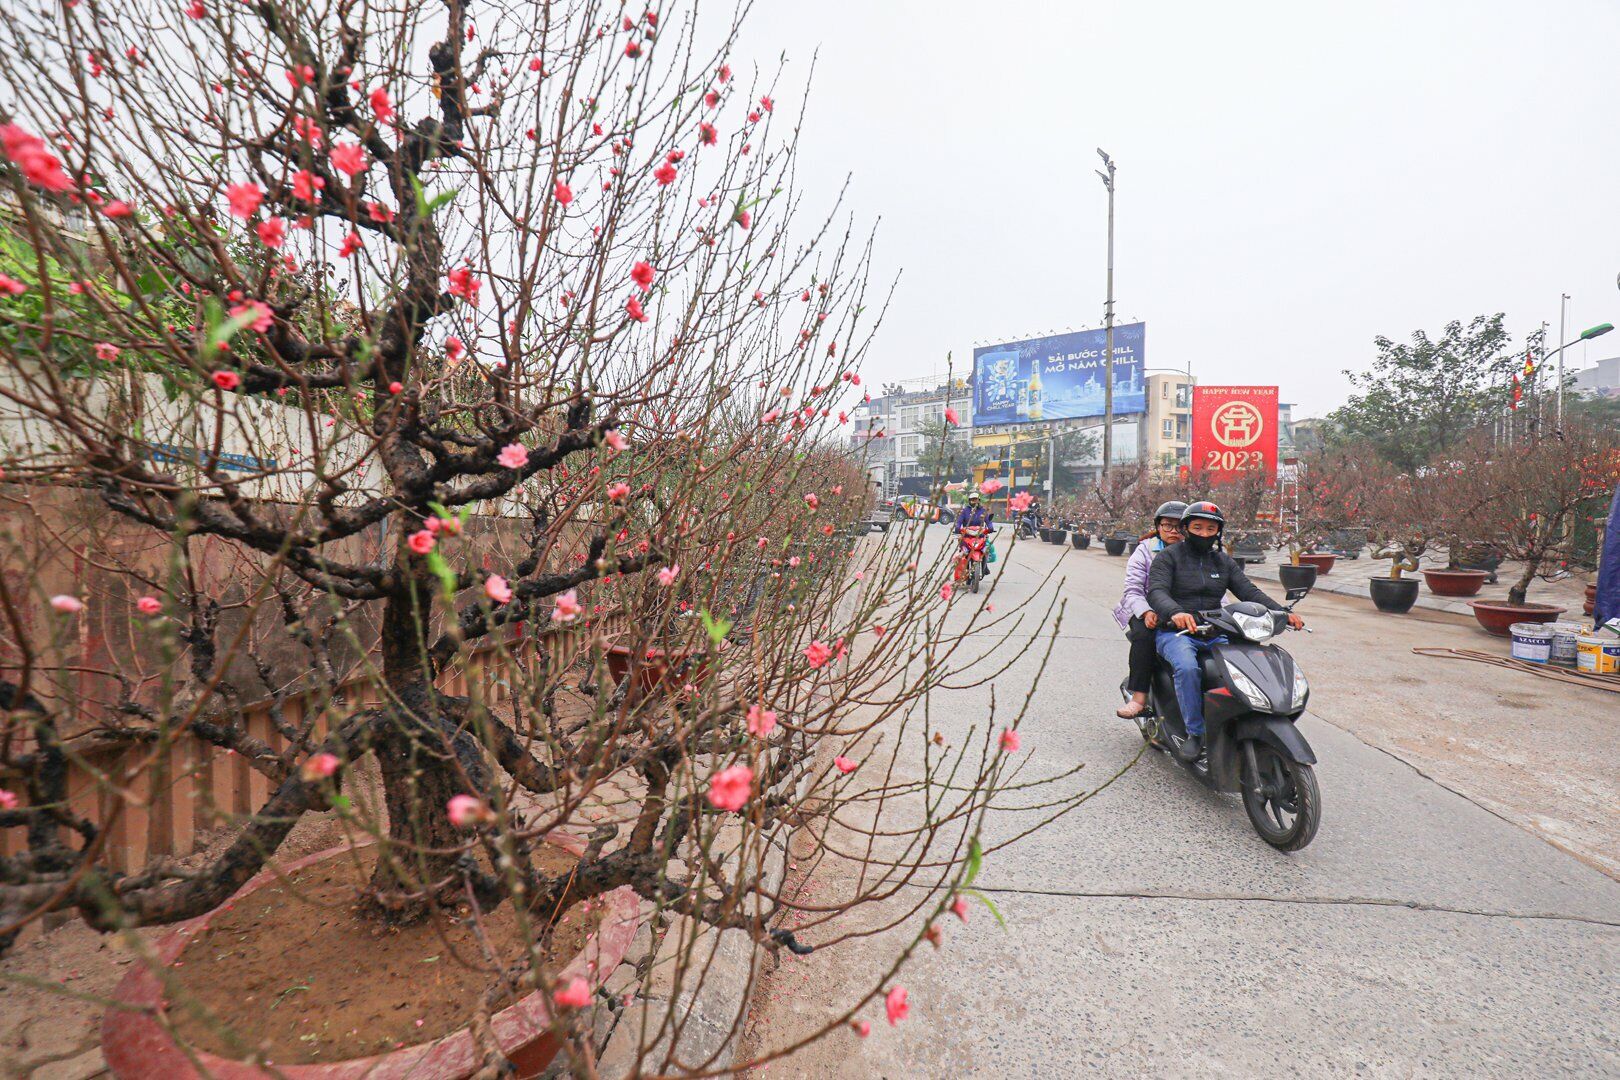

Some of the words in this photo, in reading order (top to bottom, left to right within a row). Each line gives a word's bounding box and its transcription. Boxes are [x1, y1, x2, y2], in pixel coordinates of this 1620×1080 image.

[1067, 348, 1098, 361] BƯỚC
[1101, 346, 1134, 356] CHILL
[1099, 356, 1138, 366] CHILL
[1207, 450, 1264, 471] 2023
